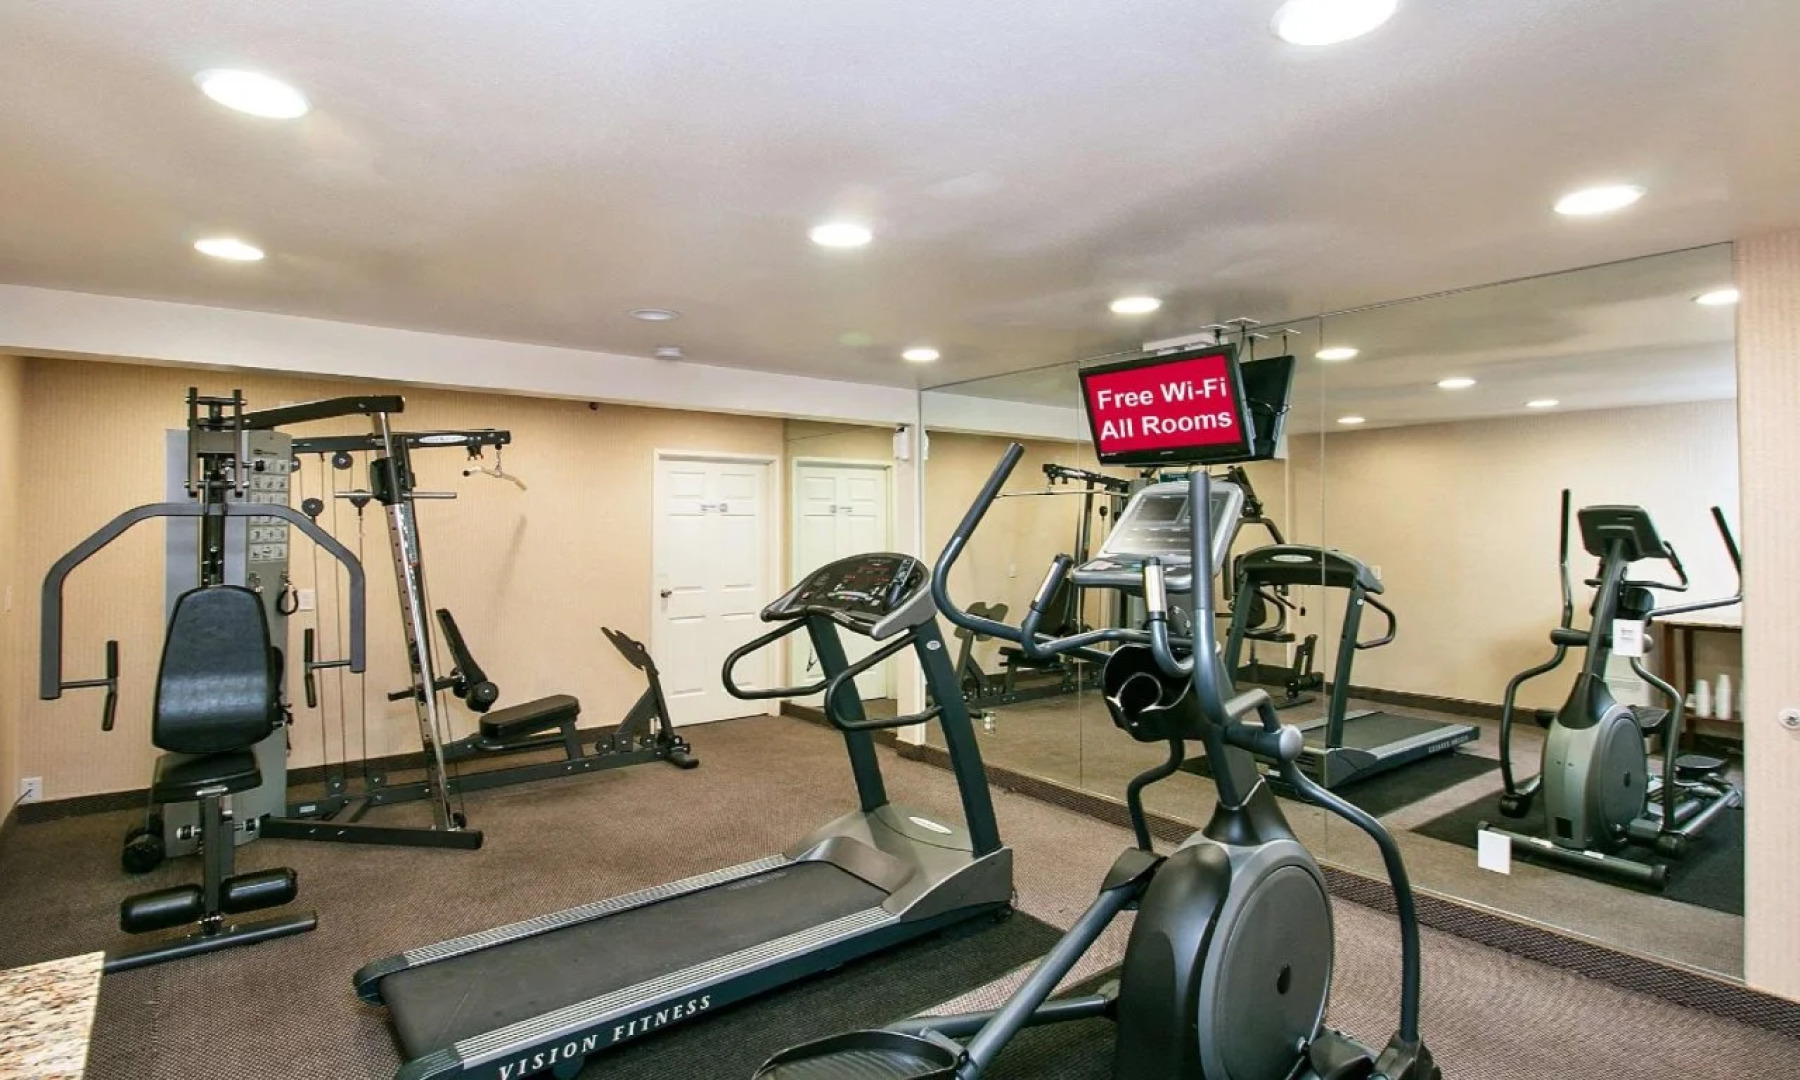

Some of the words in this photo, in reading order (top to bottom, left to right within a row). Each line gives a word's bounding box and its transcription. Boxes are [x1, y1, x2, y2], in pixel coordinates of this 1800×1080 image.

[1097, 388, 1153, 410] Free
[1160, 376, 1227, 403] Wi-Fi
[1100, 417, 1134, 441] All
[1141, 411, 1233, 436] Rooms
[498, 1034, 599, 1080] VISION
[611, 994, 712, 1042] FITNESS
